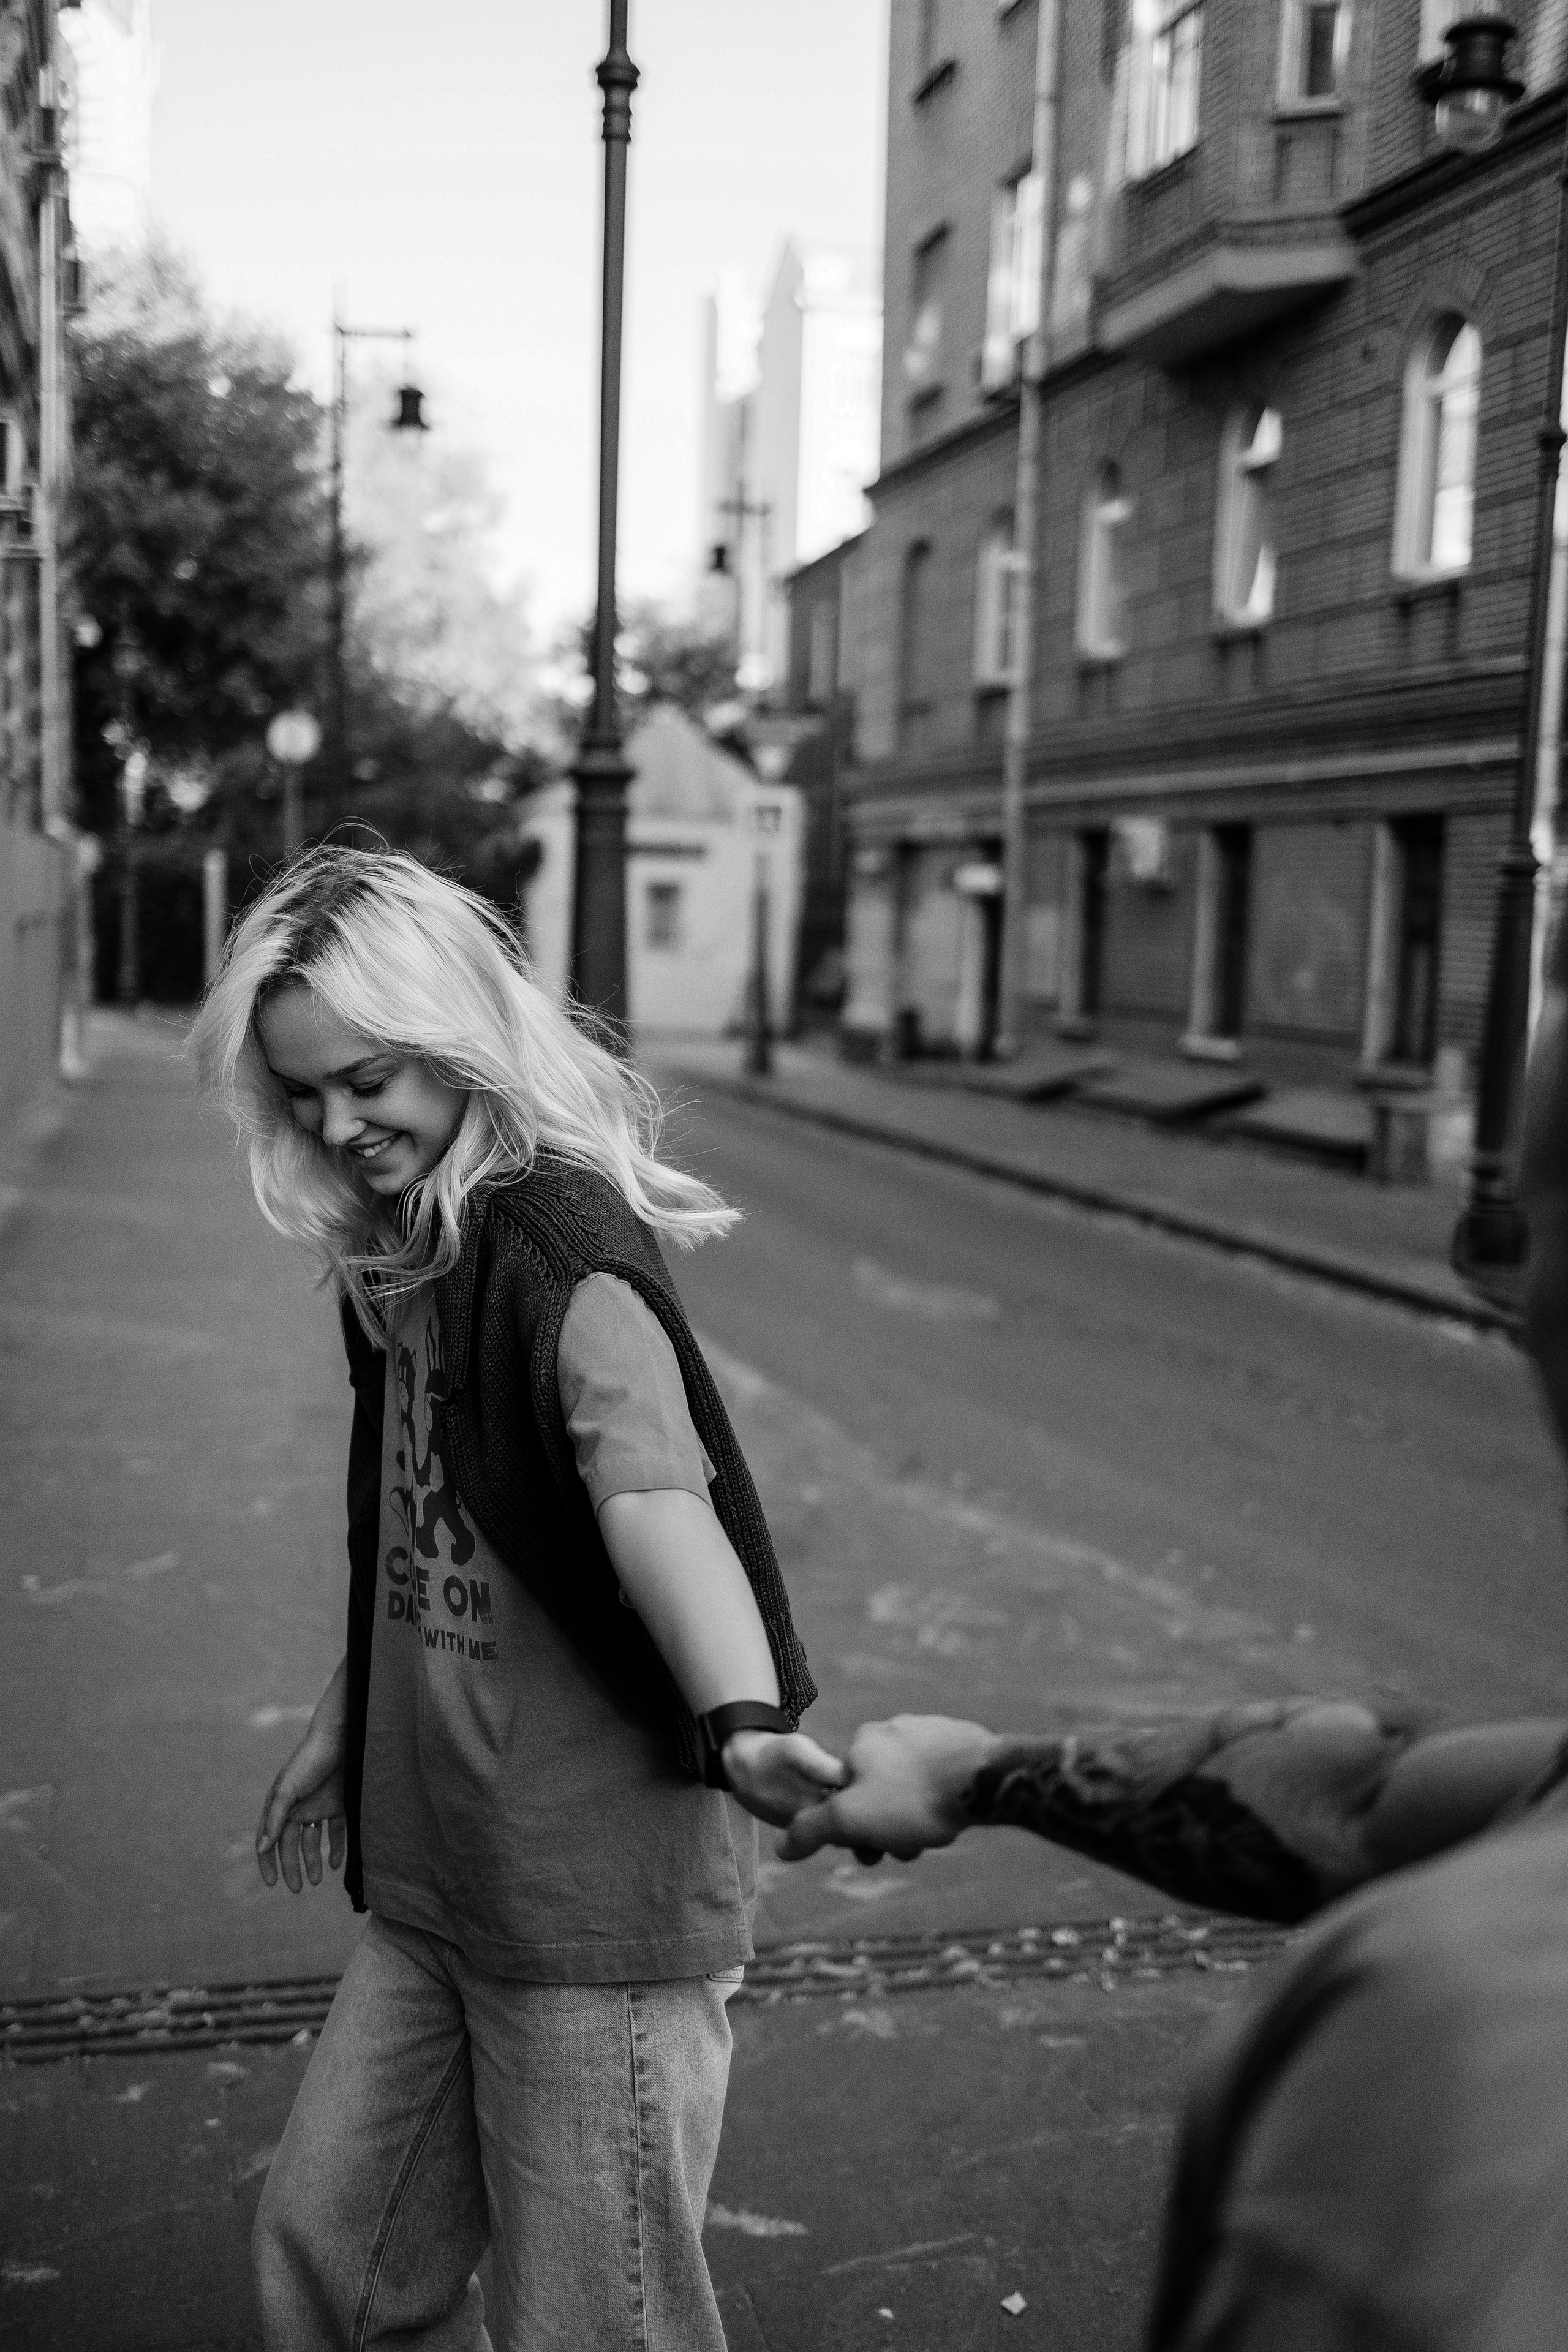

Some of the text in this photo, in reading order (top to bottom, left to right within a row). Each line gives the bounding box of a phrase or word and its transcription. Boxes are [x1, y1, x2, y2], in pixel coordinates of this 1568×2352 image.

[443, 1575, 494, 1624] ON
[423, 1627, 498, 1660] WITH ME
